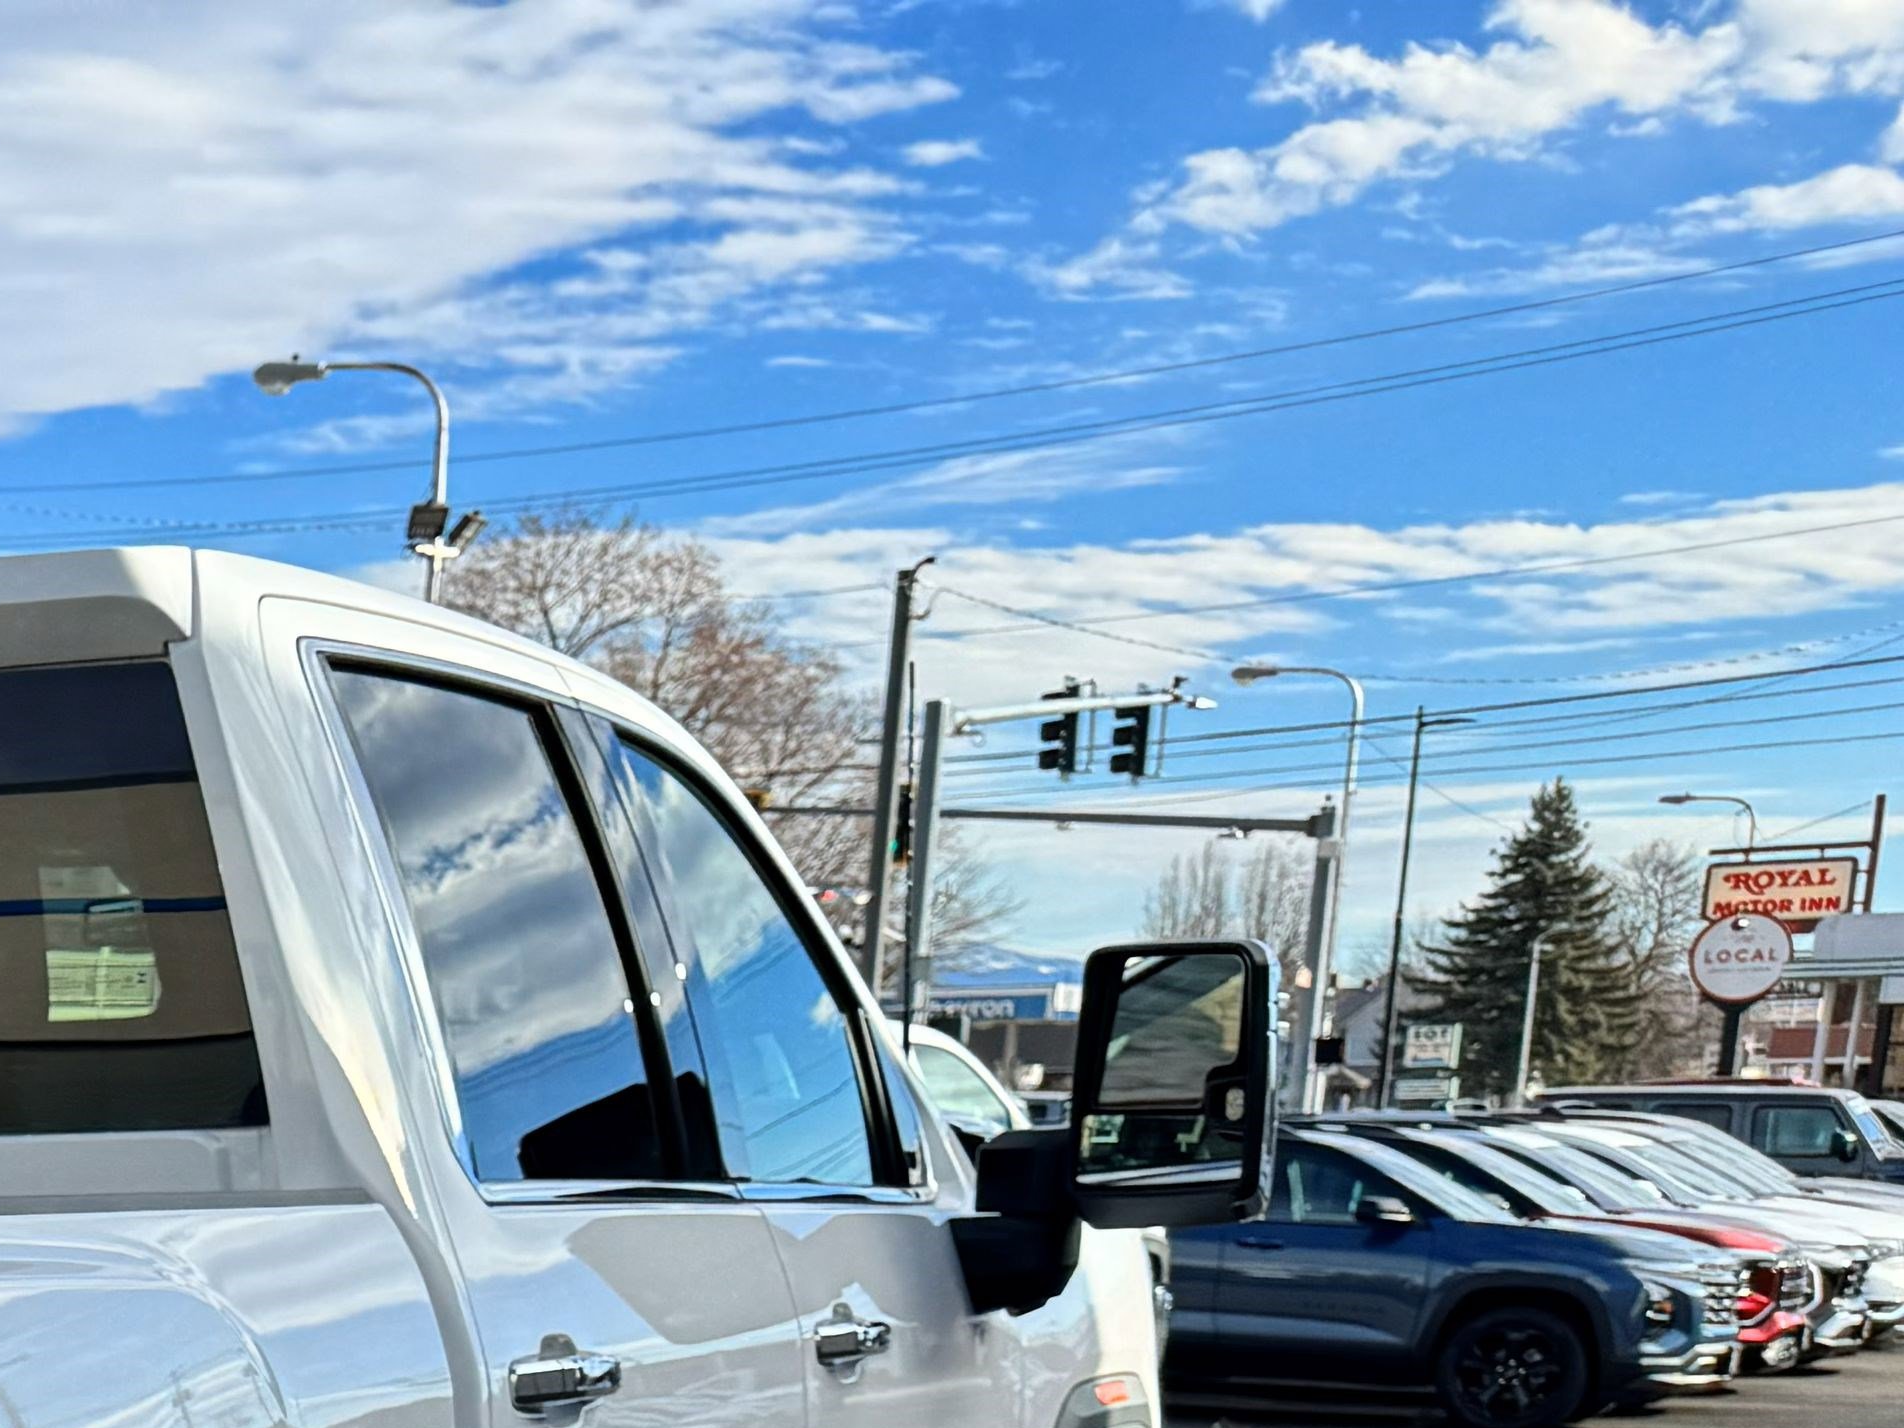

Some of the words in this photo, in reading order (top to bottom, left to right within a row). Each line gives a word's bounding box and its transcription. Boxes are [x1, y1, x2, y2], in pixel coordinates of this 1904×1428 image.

[1723, 868, 1836, 895] ROYAL
[1712, 898, 1792, 918] MOTOR
[1799, 896, 1841, 913] INN
[1703, 947, 1779, 965] LOCAL
